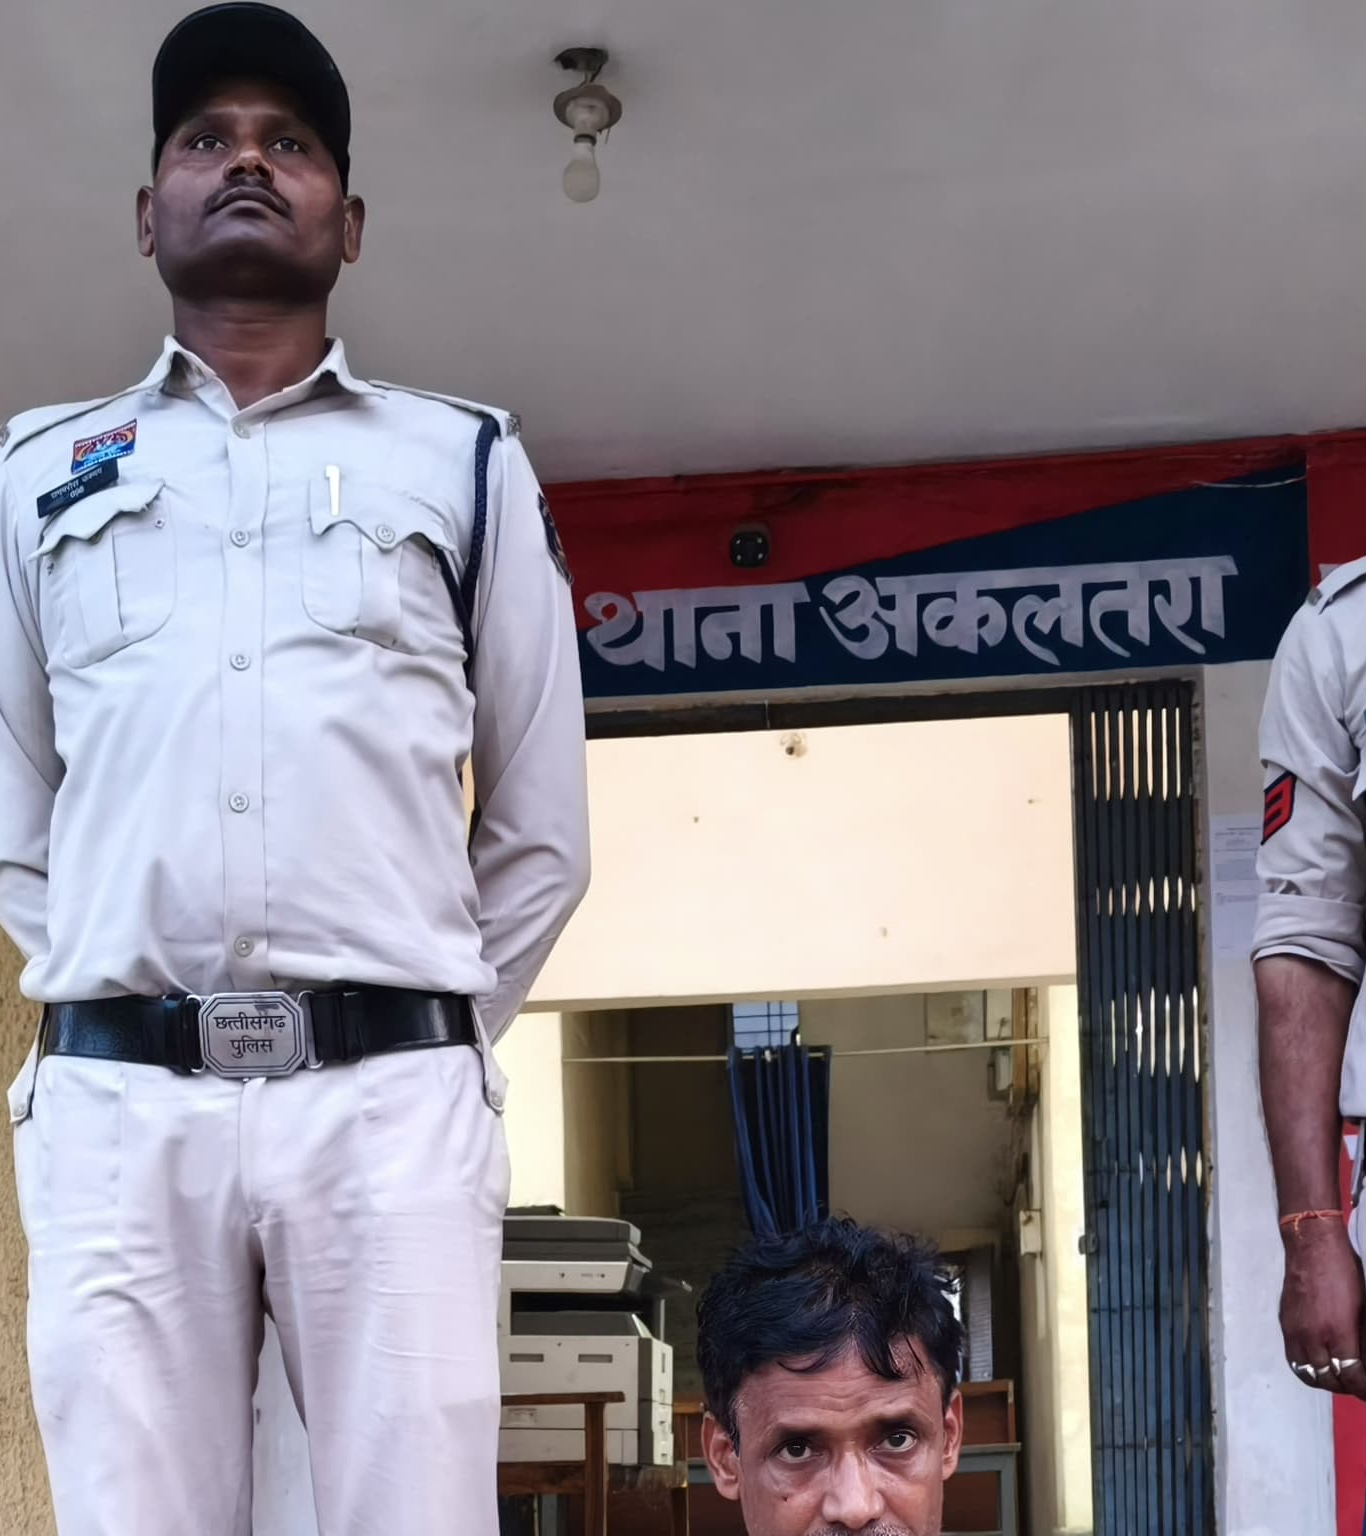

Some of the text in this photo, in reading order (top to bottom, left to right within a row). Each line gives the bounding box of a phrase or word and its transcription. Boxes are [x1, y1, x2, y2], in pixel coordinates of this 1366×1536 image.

[584, 555, 1239, 672] थाना अकलतरा
[229, 1035, 275, 1059] पुलिस
